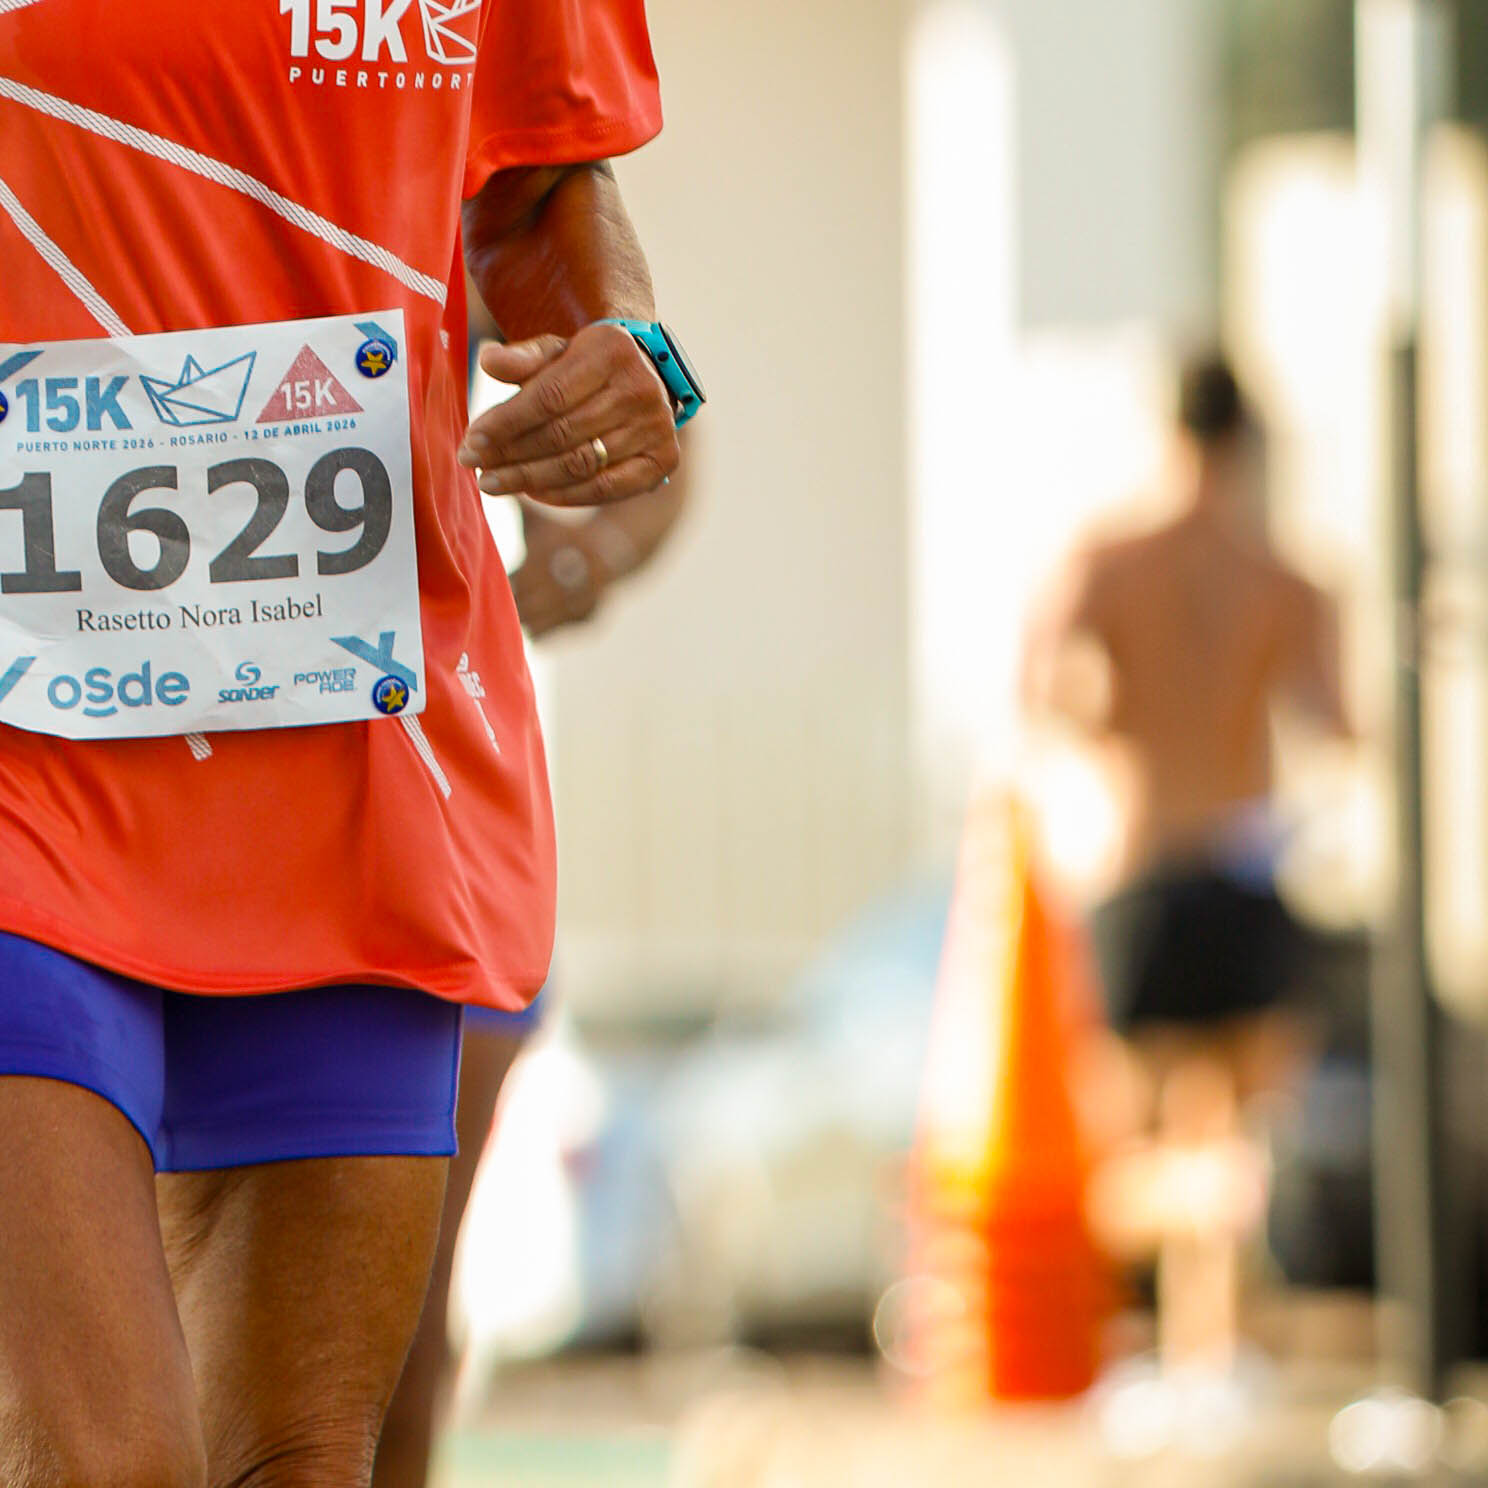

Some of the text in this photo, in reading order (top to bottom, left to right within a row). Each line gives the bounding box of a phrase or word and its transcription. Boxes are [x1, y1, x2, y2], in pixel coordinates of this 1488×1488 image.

[16, 375, 134, 433] 15K
[279, 378, 337, 411] 15K
[17, 440, 68, 453] PUERTO
[73, 439, 116, 452] NORTE
[123, 437, 154, 449] 2026
[170, 432, 228, 447] ROSARIO
[244, 430, 258, 440] 12
[264, 427, 279, 439] DE
[284, 422, 322, 437] ABRIL
[327, 417, 357, 432] 2026
[76, 593, 324, 632] Rasetto Nora Isabel
[47, 659, 191, 712] osde
[293, 667, 358, 687] POWER
